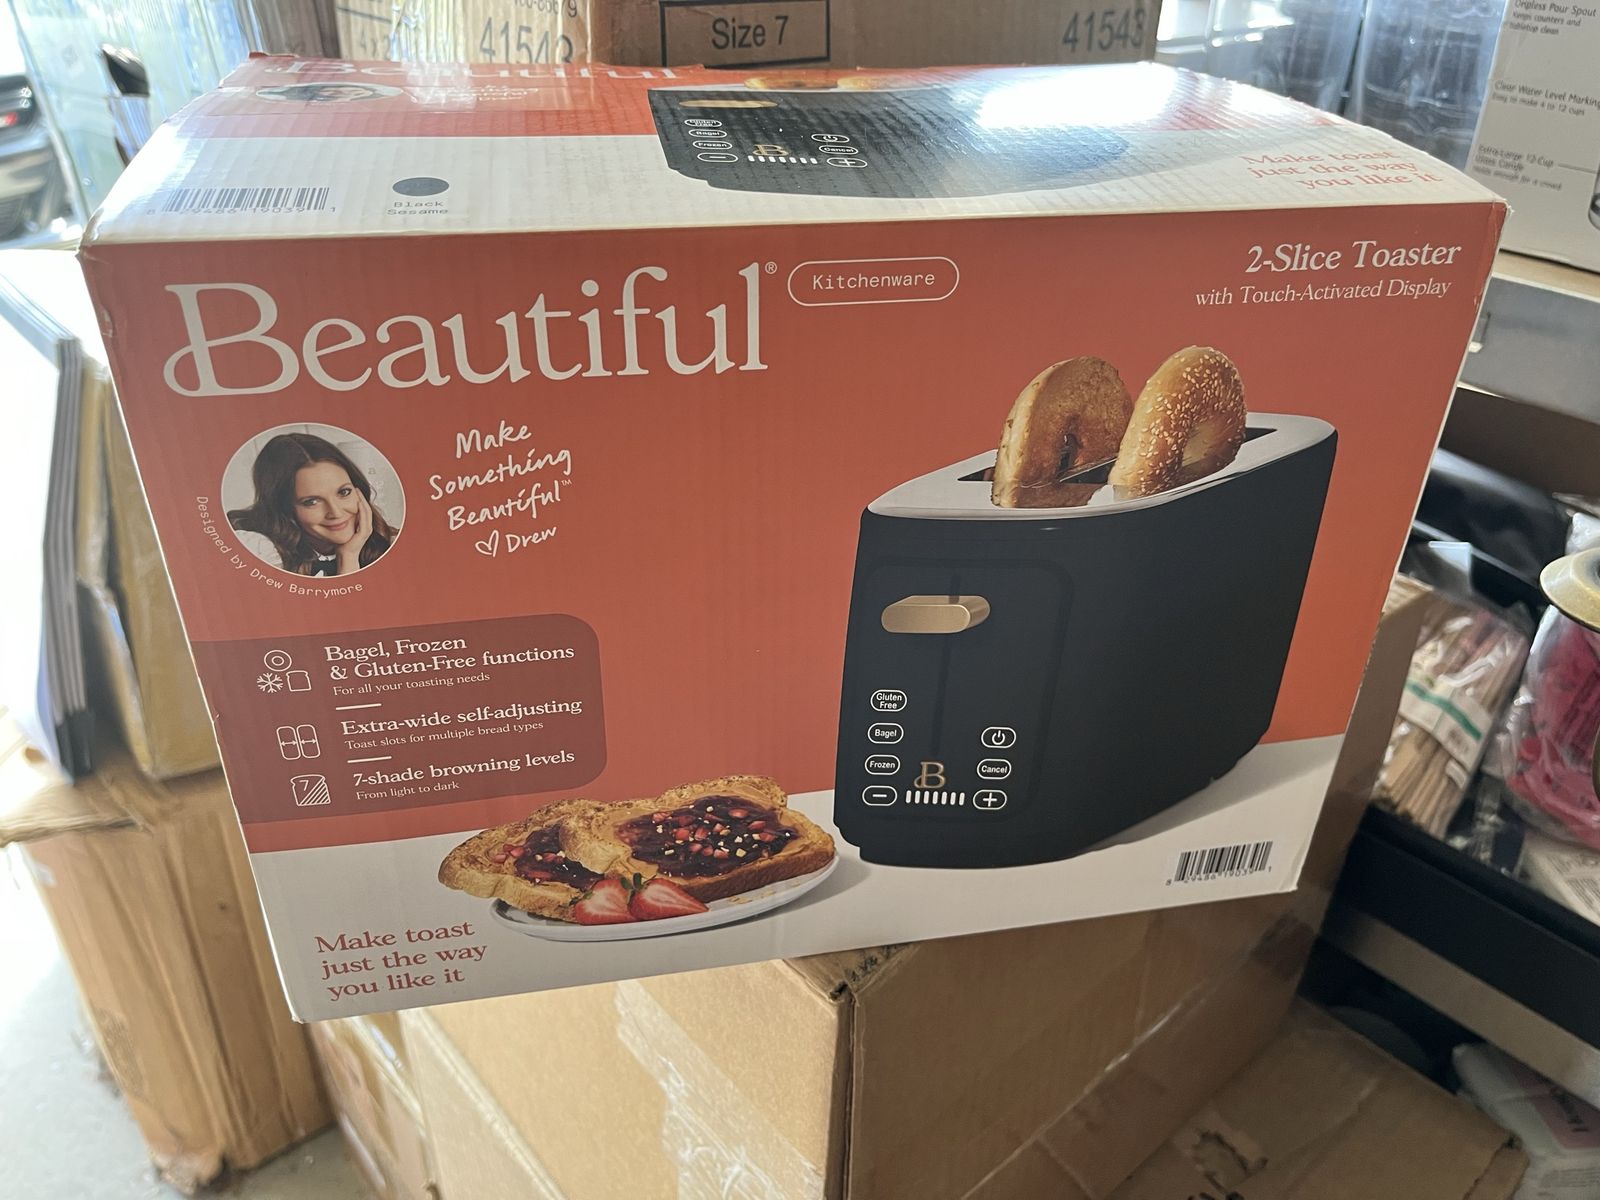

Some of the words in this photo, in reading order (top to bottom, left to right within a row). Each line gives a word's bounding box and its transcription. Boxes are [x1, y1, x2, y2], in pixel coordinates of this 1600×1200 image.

[1549, 3, 1570, 13] Pour
[1572, 6, 1597, 17] Spout
[712, 17, 766, 49] Size
[775, 15, 789, 45] 7
[1062, 8, 1146, 52] 41543
[1519, 85, 1542, 96] Water
[1545, 89, 1567, 101] Level
[1240, 153, 1324, 165] Make
[1327, 150, 1400, 161] toast
[1248, 166, 1306, 178] just
[1310, 164, 1359, 174] the
[1364, 161, 1418, 173] way
[1296, 176, 1354, 189] you
[1354, 173, 1413, 185] like
[1414, 172, 1443, 183] it
[1245, 243, 1342, 273] 2-Slice
[1352, 240, 1463, 269] Toaster
[1196, 287, 1233, 305] with
[1240, 279, 1383, 303] Touch-Activated
[1386, 276, 1451, 299] Display
[163, 261, 768, 398] Beautiful
[812, 273, 935, 290] Kitchenware
[456, 420, 531, 458] Make
[429, 448, 571, 500] Something
[196, 496, 232, 554] Designed
[230, 554, 247, 569] by
[250, 568, 283, 590] Drew
[289, 583, 363, 598] Barrymore
[505, 527, 557, 553] Drew
[324, 641, 391, 662] Bagel,
[395, 638, 467, 655] Frozen
[330, 665, 348, 681] &
[354, 655, 476, 678] Gluten-Free
[482, 647, 575, 666] functions
[333, 685, 355, 696] For
[357, 683, 372, 693] all
[375, 681, 403, 692] your
[406, 675, 454, 689] toasting
[456, 672, 490, 684] needs
[876, 692, 902, 701] Gluten
[341, 711, 452, 736] Extra-wide
[457, 700, 582, 723] self-adjusting
[879, 701, 898, 710] Free
[344, 740, 378, 750] Toast
[380, 736, 407, 746] slots
[409, 733, 426, 743] for
[428, 728, 475, 741] multiple
[477, 724, 511, 736] bread
[513, 720, 544, 733] types
[874, 729, 897, 739] Bagel
[353, 768, 425, 787] 7-shade
[429, 758, 521, 778] browning
[525, 750, 575, 767] levels
[869, 761, 896, 769] Frozen
[981, 765, 1008, 773] Cancel
[356, 790, 388, 801] From
[390, 786, 416, 797] light
[418, 784, 431, 793] to
[433, 780, 460, 791] dark
[314, 931, 397, 953] Make
[405, 921, 476, 943] toast
[322, 957, 375, 981] just
[382, 951, 427, 968] the
[435, 945, 487, 962] way
[327, 981, 380, 1001] you
[387, 972, 436, 990] like
[444, 968, 465, 983] it
